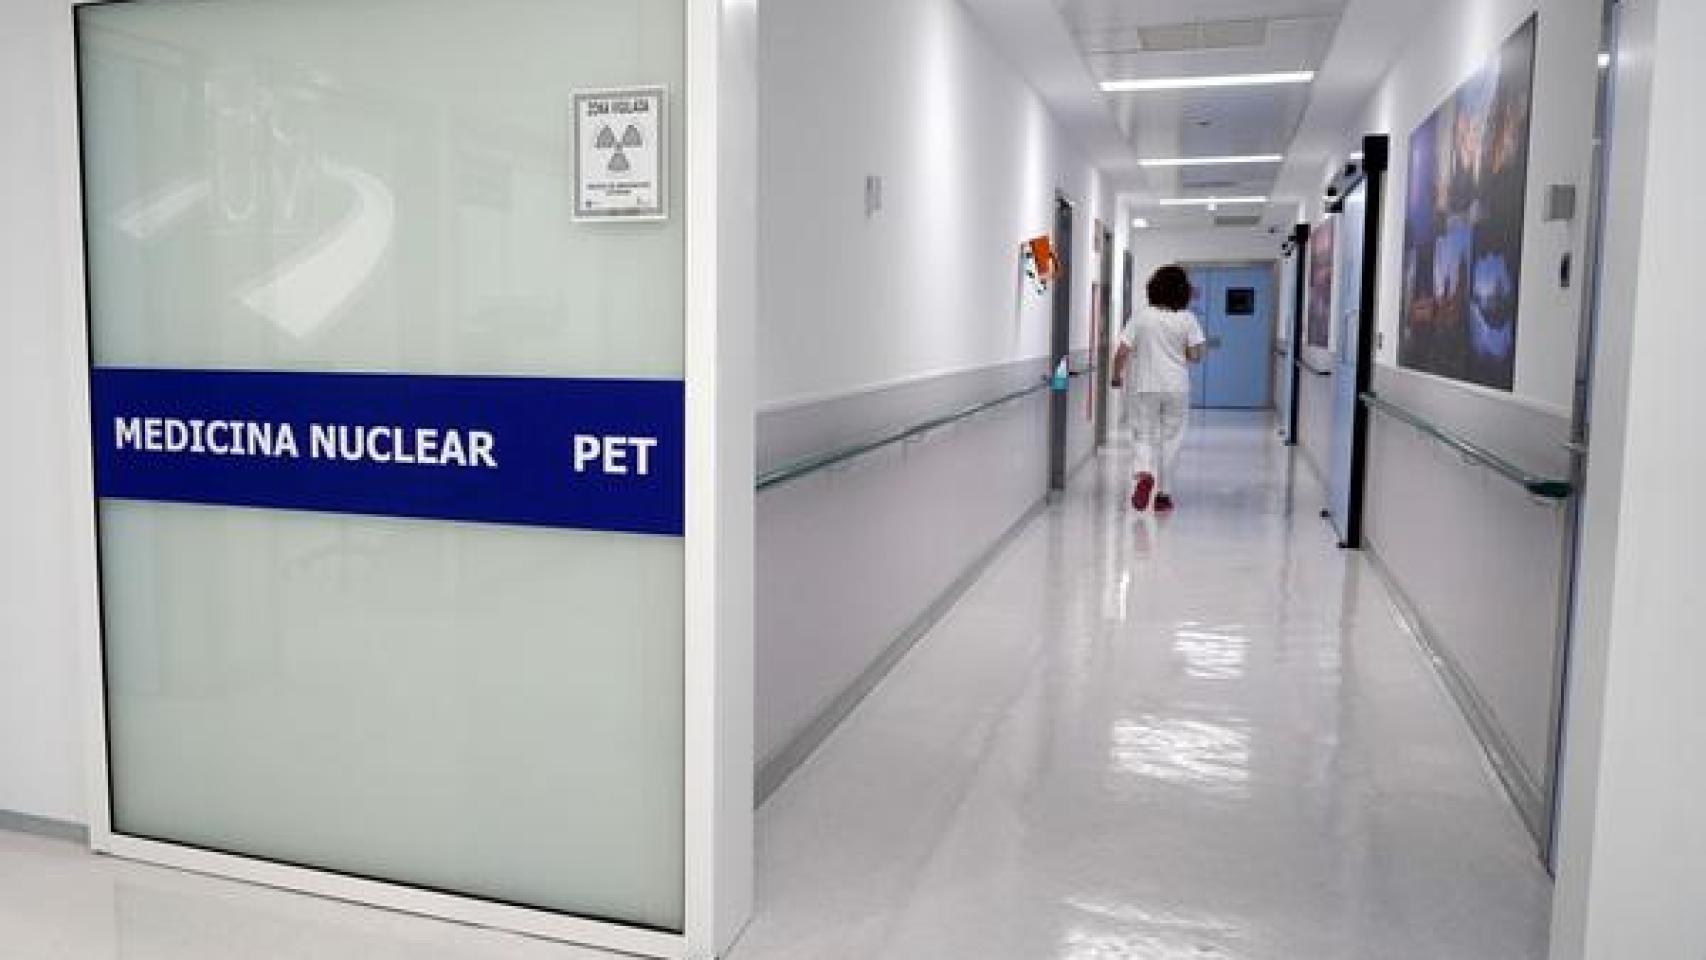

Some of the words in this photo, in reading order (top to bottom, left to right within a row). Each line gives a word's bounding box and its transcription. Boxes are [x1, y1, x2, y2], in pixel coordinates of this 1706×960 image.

[115, 416, 299, 459] MEDICINA
[309, 423, 498, 468] NUCLEAR
[573, 434, 658, 476] PET
